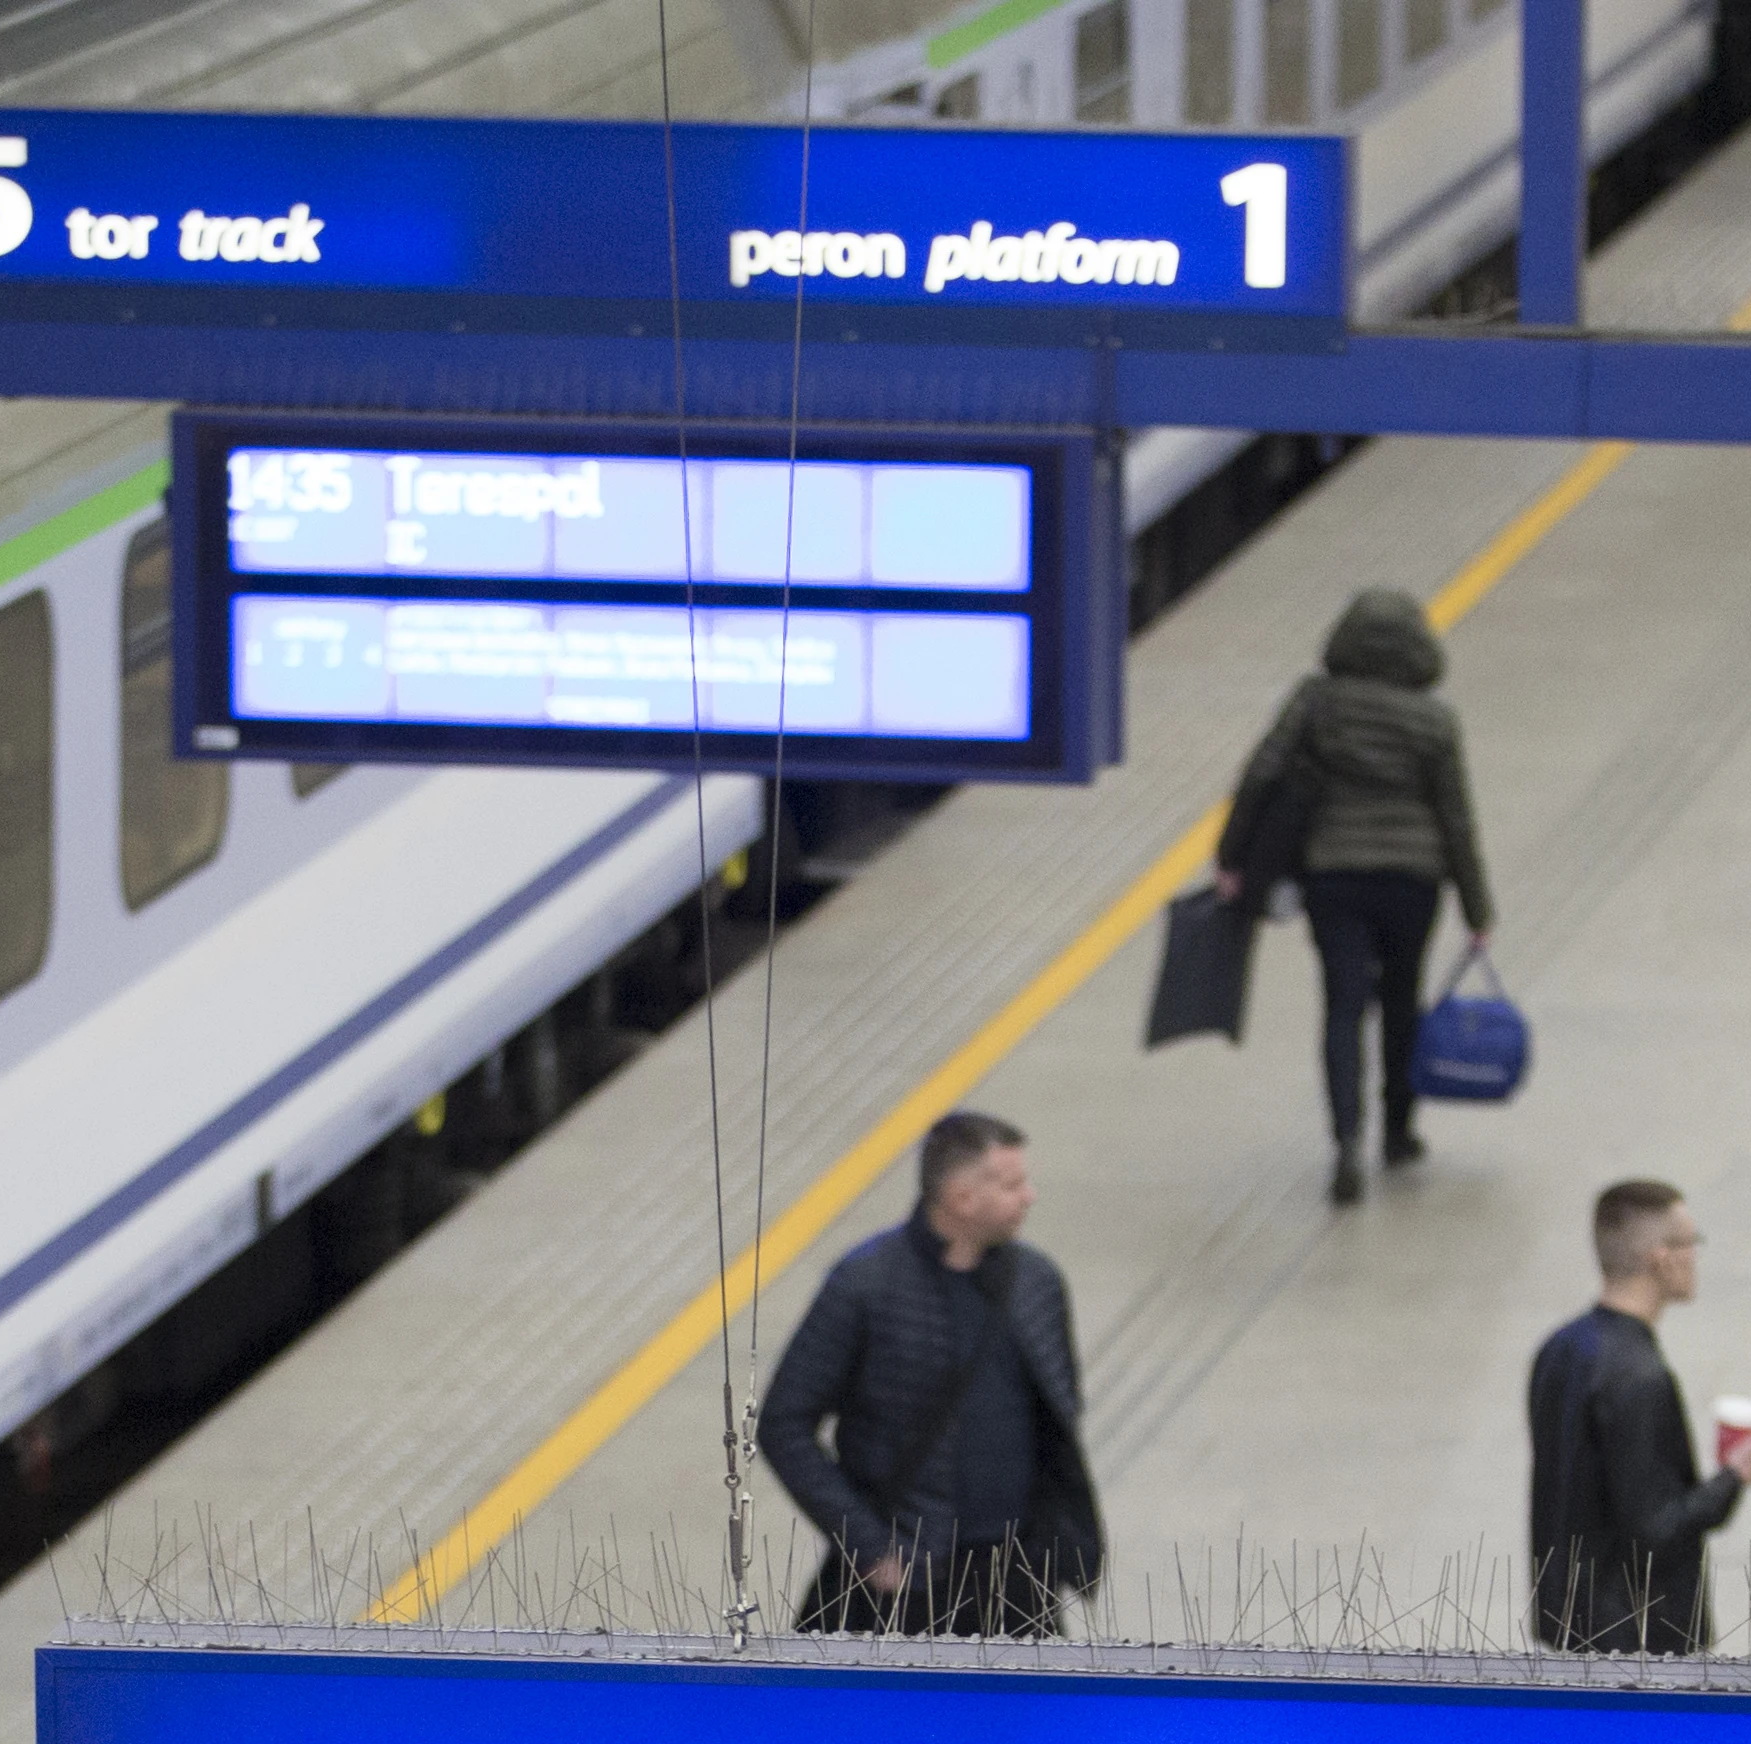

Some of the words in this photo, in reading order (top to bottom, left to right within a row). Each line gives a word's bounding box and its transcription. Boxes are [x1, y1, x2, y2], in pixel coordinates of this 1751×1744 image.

[64, 206, 160, 261] tor
[177, 202, 326, 264] track
[728, 228, 908, 288] peron
[922, 219, 1181, 294] platform
[1219, 161, 1289, 290] 1
